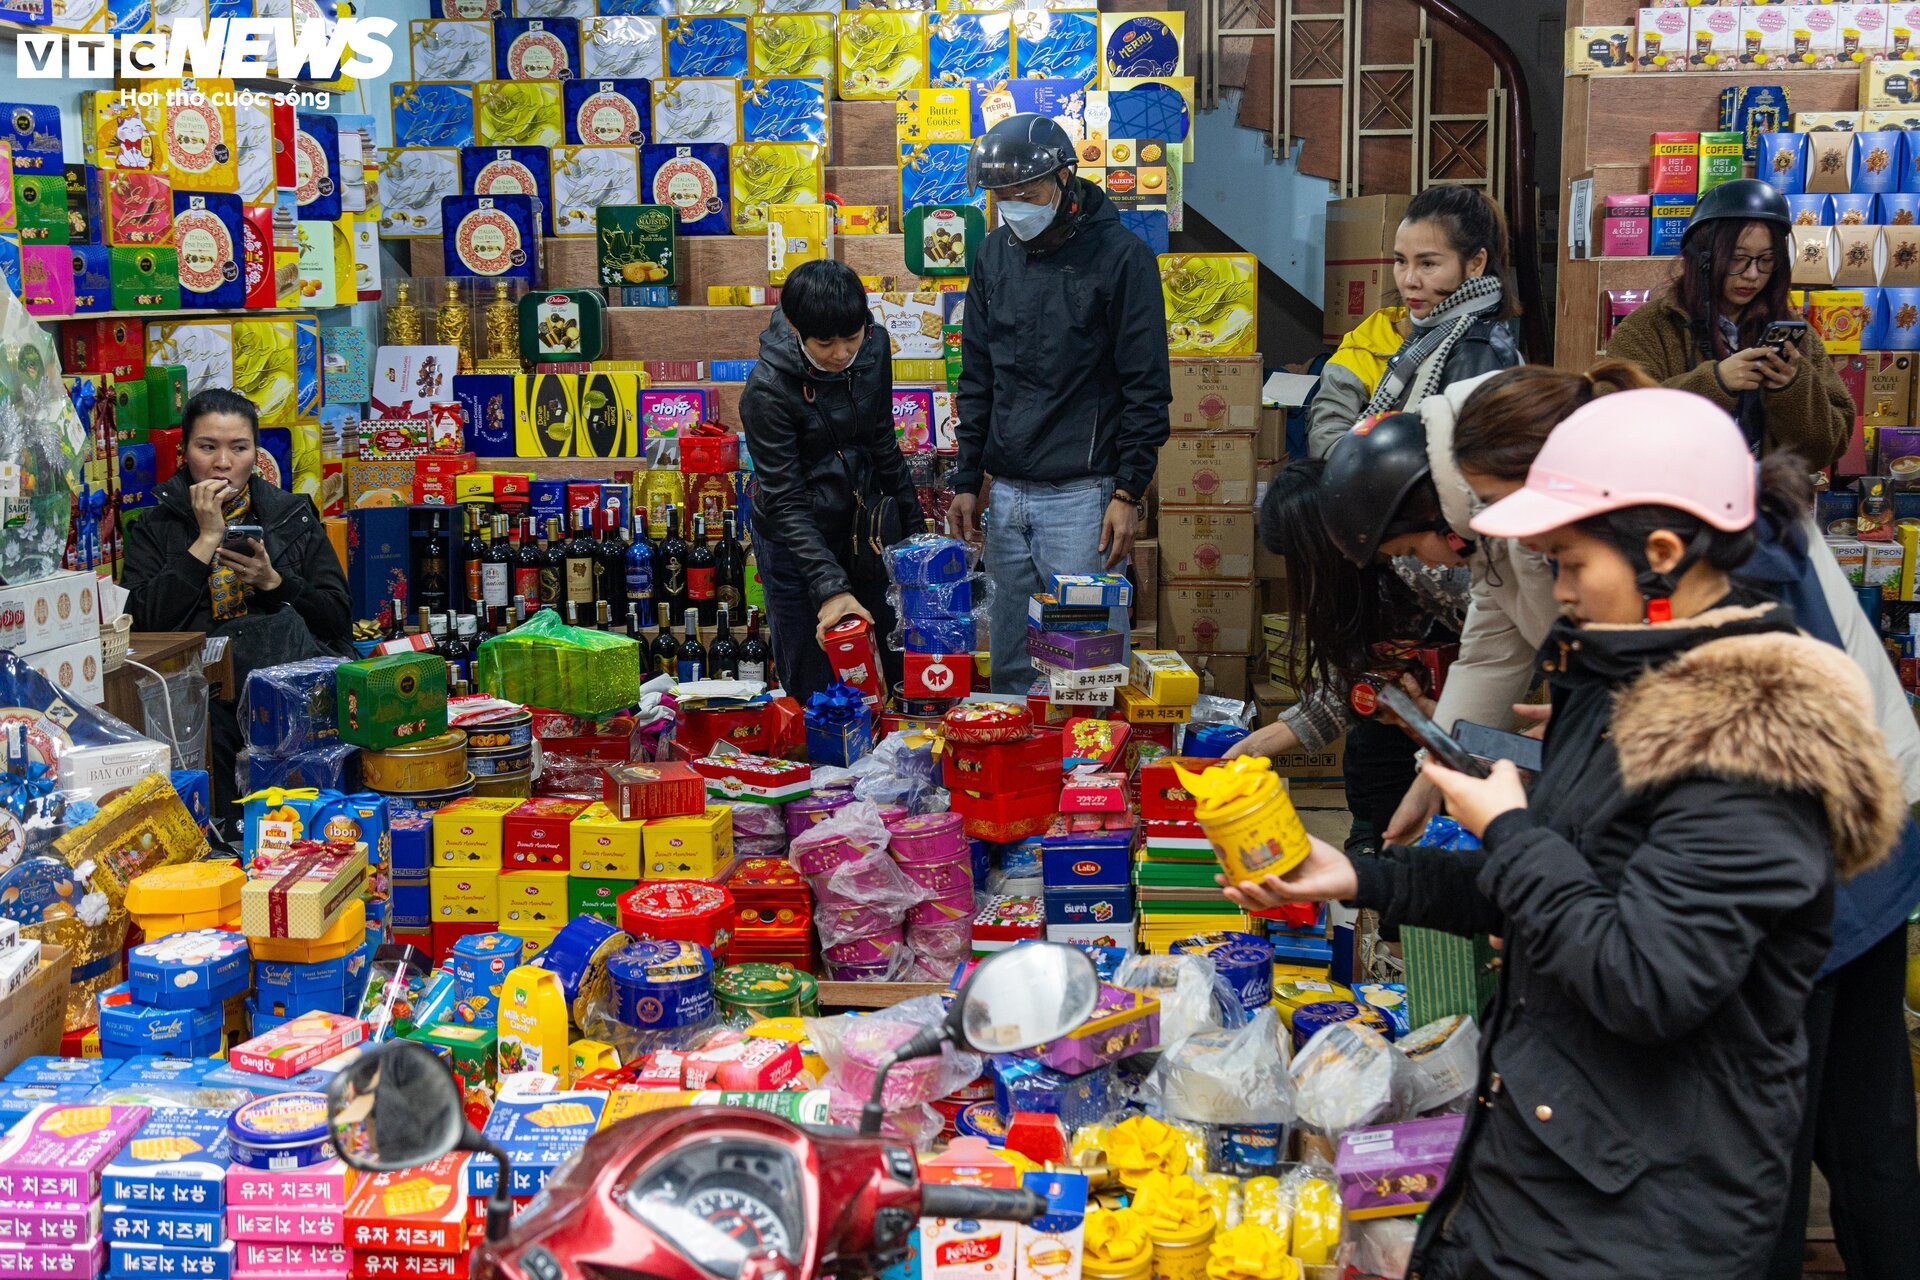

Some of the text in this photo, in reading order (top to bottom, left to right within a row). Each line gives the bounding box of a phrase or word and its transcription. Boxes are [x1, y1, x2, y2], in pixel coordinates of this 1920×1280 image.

[1118, 31, 1153, 58] MERRY
[929, 106, 958, 116] Butter
[926, 116, 961, 127] Cookies
[1659, 146, 1693, 154] COFFEE
[1705, 146, 1739, 154] COFFEE
[1657, 207, 1691, 215] COFFEE
[639, 217, 668, 225] MAJESTIC
[1872, 375, 1899, 383] ROYAL
[1079, 673, 1122, 685] 유자 치즈케
[1055, 690, 1084, 701] 치즈케
[1137, 709, 1184, 719] 유자 치즈케
[90, 769, 112, 781] BAN
[330, 827, 357, 837] ibon
[503, 1008, 538, 1027] Milk Soft
[510, 1020, 531, 1034] Candy
[22, 1176, 78, 1197] 치즈케
[115, 1182, 207, 1204] 유자 치즈케
[240, 1181, 331, 1200] 유자 치즈케
[39, 1218, 78, 1240] 유자
[112, 1218, 213, 1243] 유자 치즈케
[237, 1214, 335, 1236] 유자 치즈케
[355, 1225, 446, 1248] 유자 치즈케
[40, 1253, 76, 1273] 유자
[123, 1251, 216, 1274] 유자 치즈케
[248, 1245, 346, 1266] 유자 치즈케
[364, 1253, 456, 1275] 유자 치즈케
